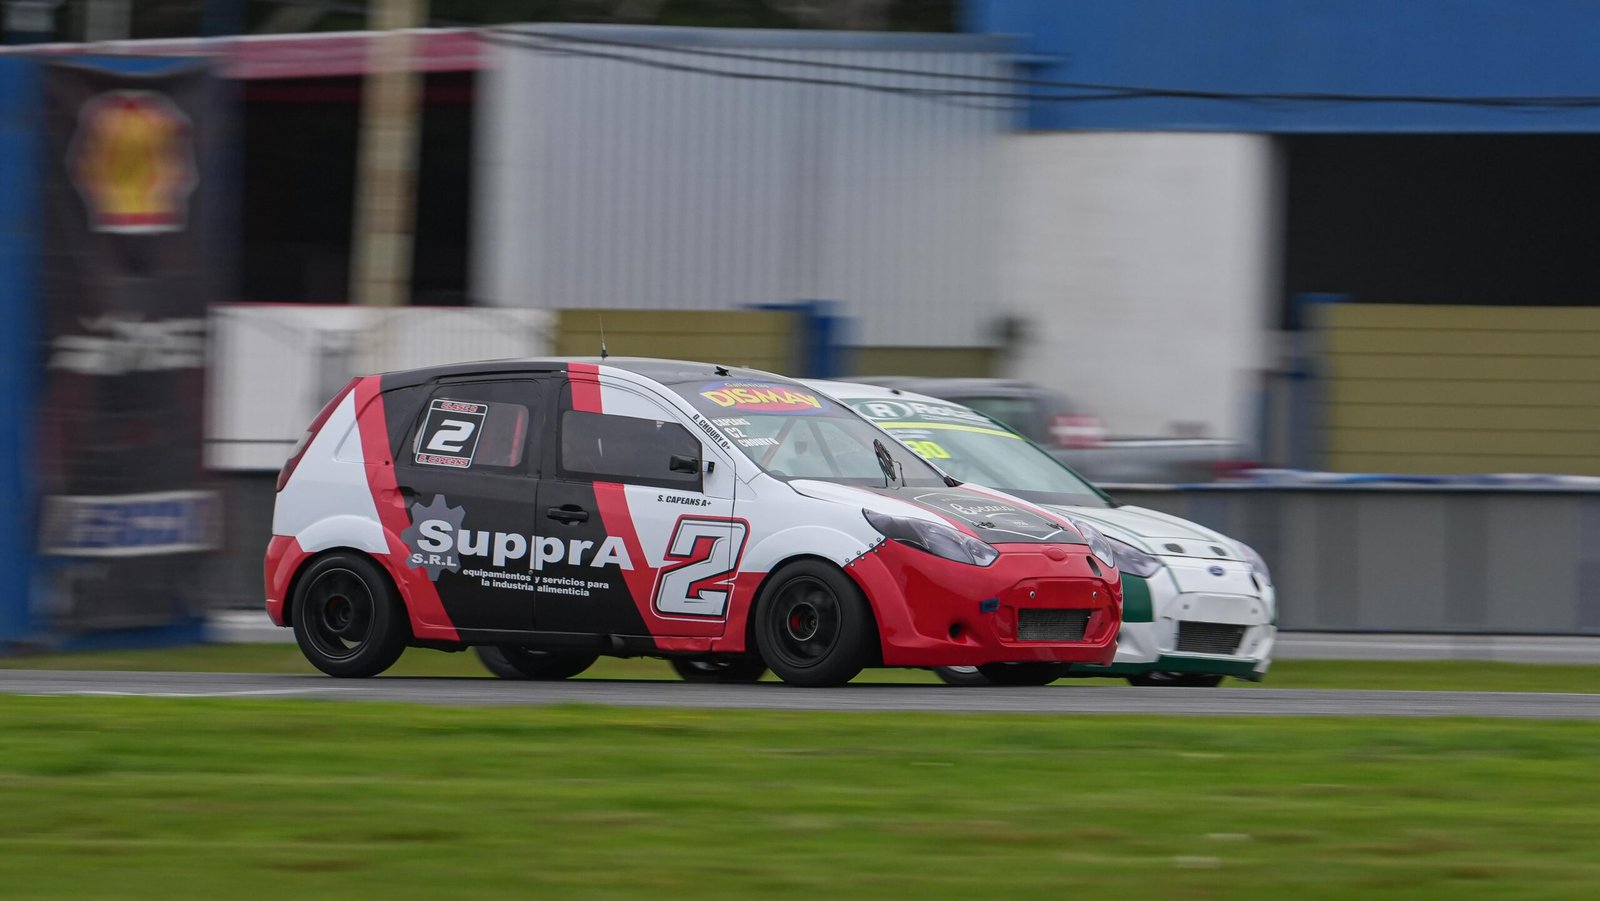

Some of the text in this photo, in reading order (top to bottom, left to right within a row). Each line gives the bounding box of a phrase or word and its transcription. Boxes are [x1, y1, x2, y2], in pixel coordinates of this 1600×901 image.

[700, 388, 822, 408] DISMAY
[426, 419, 475, 452] 2
[698, 419, 724, 443] CHOURY
[657, 494, 665, 503] S.
[665, 495, 700, 506] CAPEANS
[416, 519, 635, 572] SupprA
[411, 553, 457, 567] S.R.L
[652, 515, 750, 621] 2
[462, 568, 609, 589] equipamientos y servicios para
[481, 578, 590, 597] la industria alimenticia
